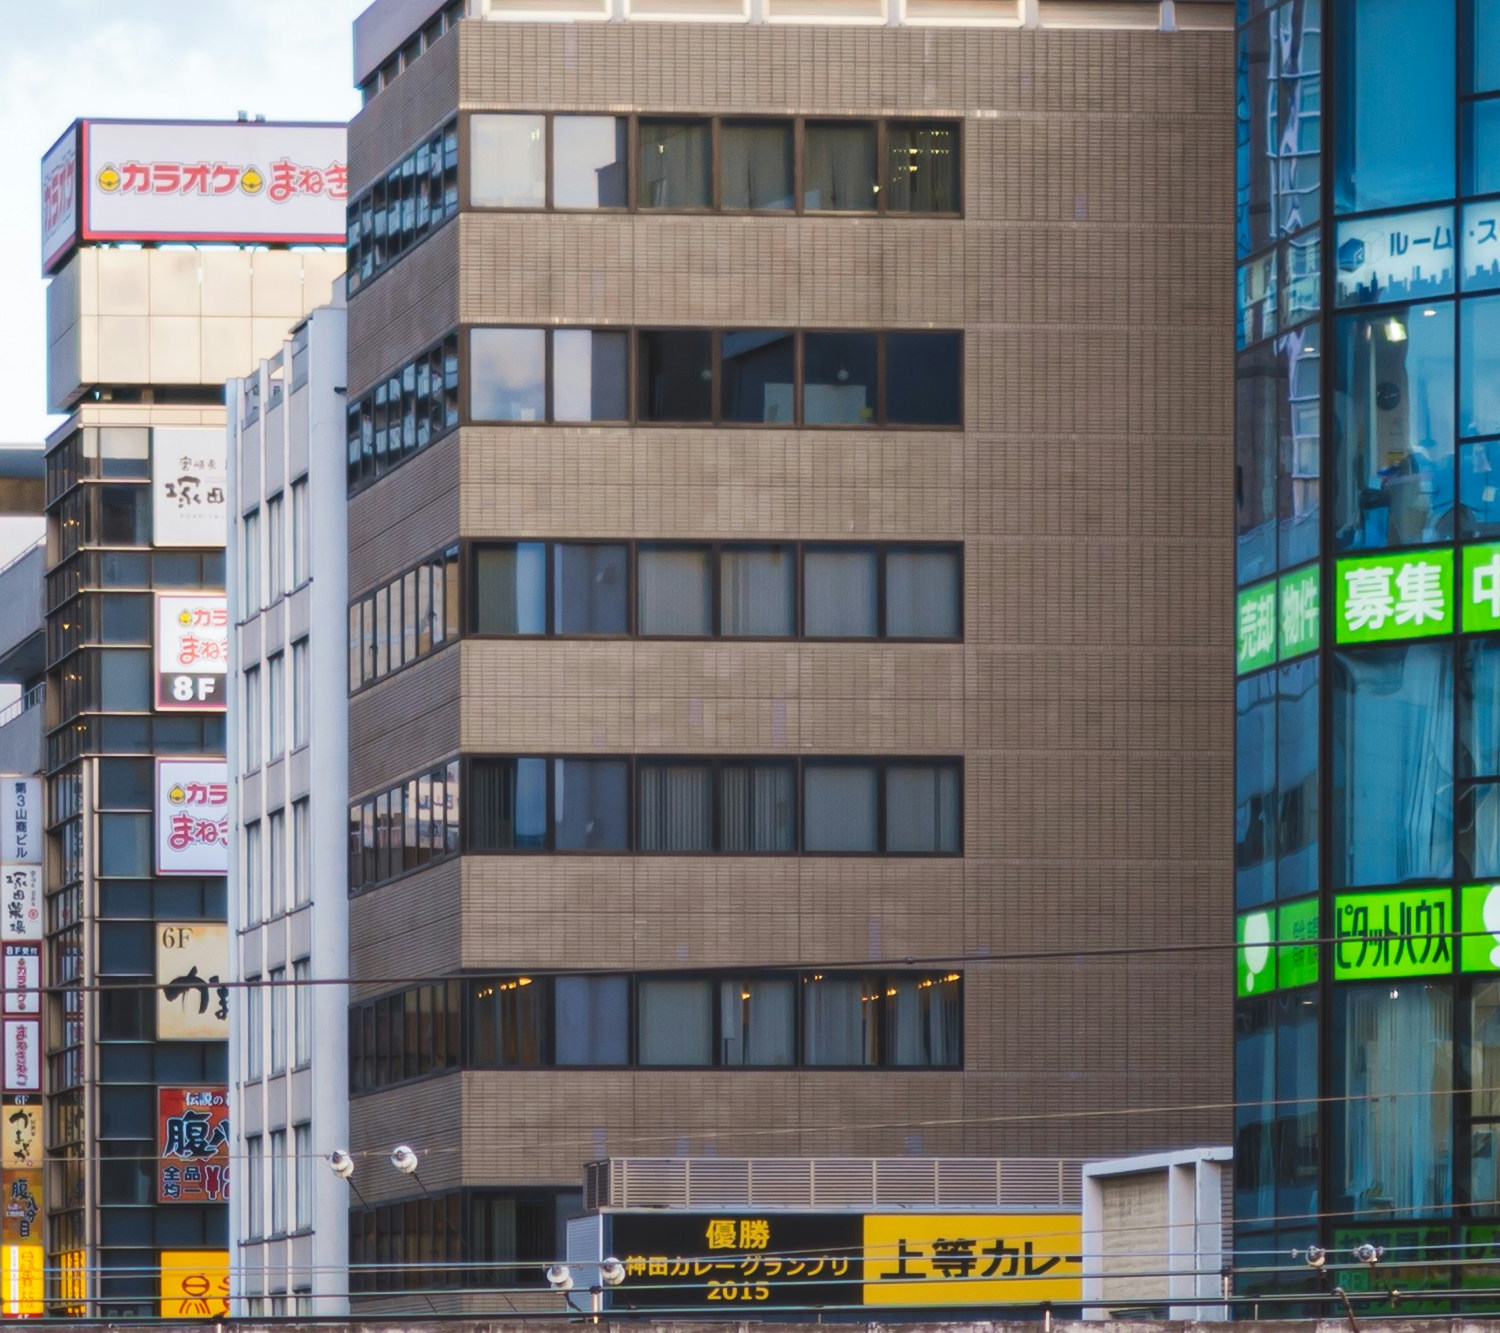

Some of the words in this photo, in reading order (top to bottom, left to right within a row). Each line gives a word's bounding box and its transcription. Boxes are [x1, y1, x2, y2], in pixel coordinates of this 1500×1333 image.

[122, 163, 240, 193] カラオケ
[172, 676, 216, 702] 8F
[15, 782, 28, 859] 第3山商ビル
[161, 927, 193, 950] 6F
[1335, 898, 1451, 970] ピタットハウス
[14, 1094, 30, 1106] 6F
[704, 1219, 771, 1250] 優勝
[624, 1253, 850, 1278] 神田カレーグランプリ
[706, 1280, 770, 1301] 2015
